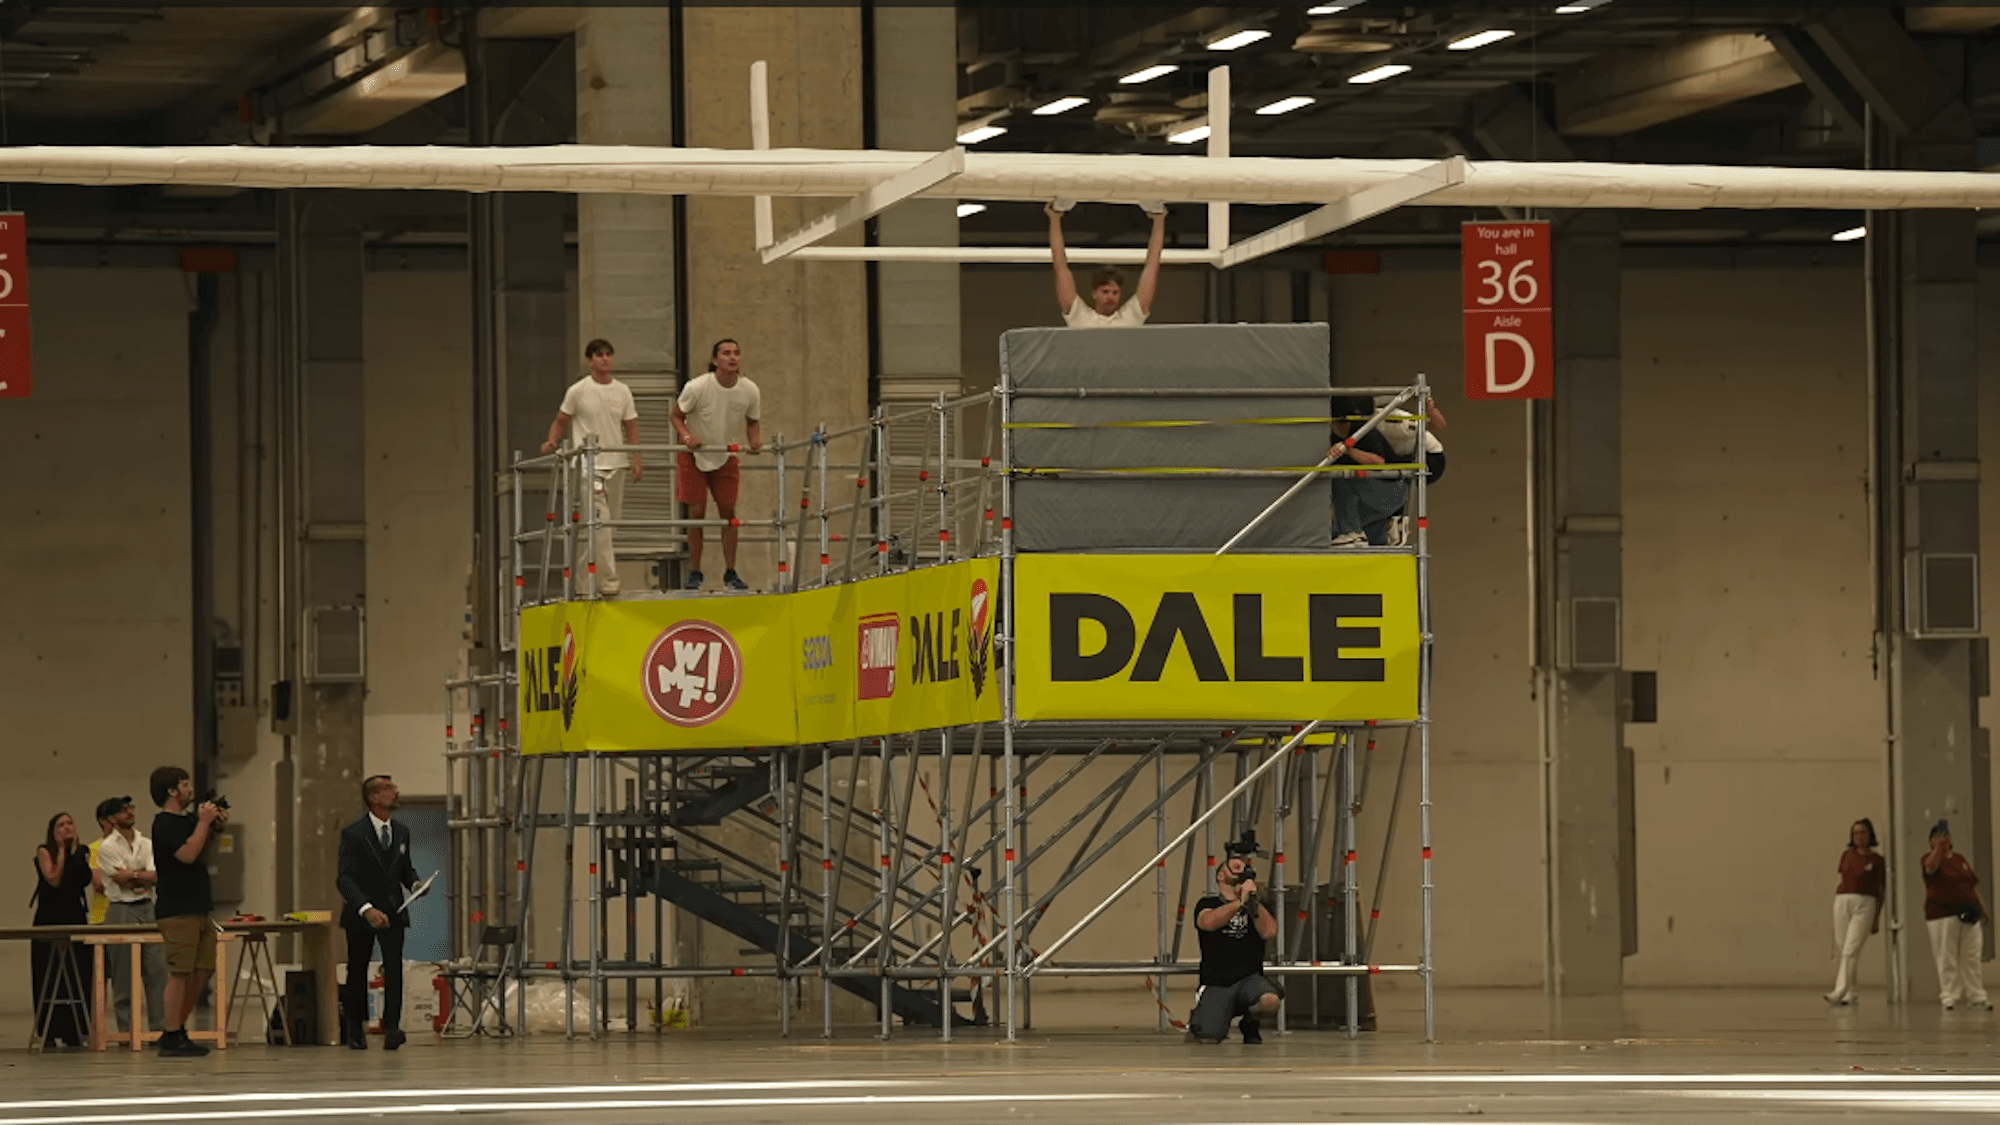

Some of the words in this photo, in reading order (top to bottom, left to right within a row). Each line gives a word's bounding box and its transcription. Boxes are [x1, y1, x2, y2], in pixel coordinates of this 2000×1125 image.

[1477, 227, 1500, 239] You
[1501, 228, 1521, 239] are
[1523, 227, 1535, 238] in
[1495, 243, 1517, 255] hall
[1477, 259, 1538, 305] 36
[1493, 315, 1522, 327] Aisle
[1485, 331, 1535, 393] D
[910, 607, 961, 685] DALE
[1049, 592, 1385, 682] DALE
